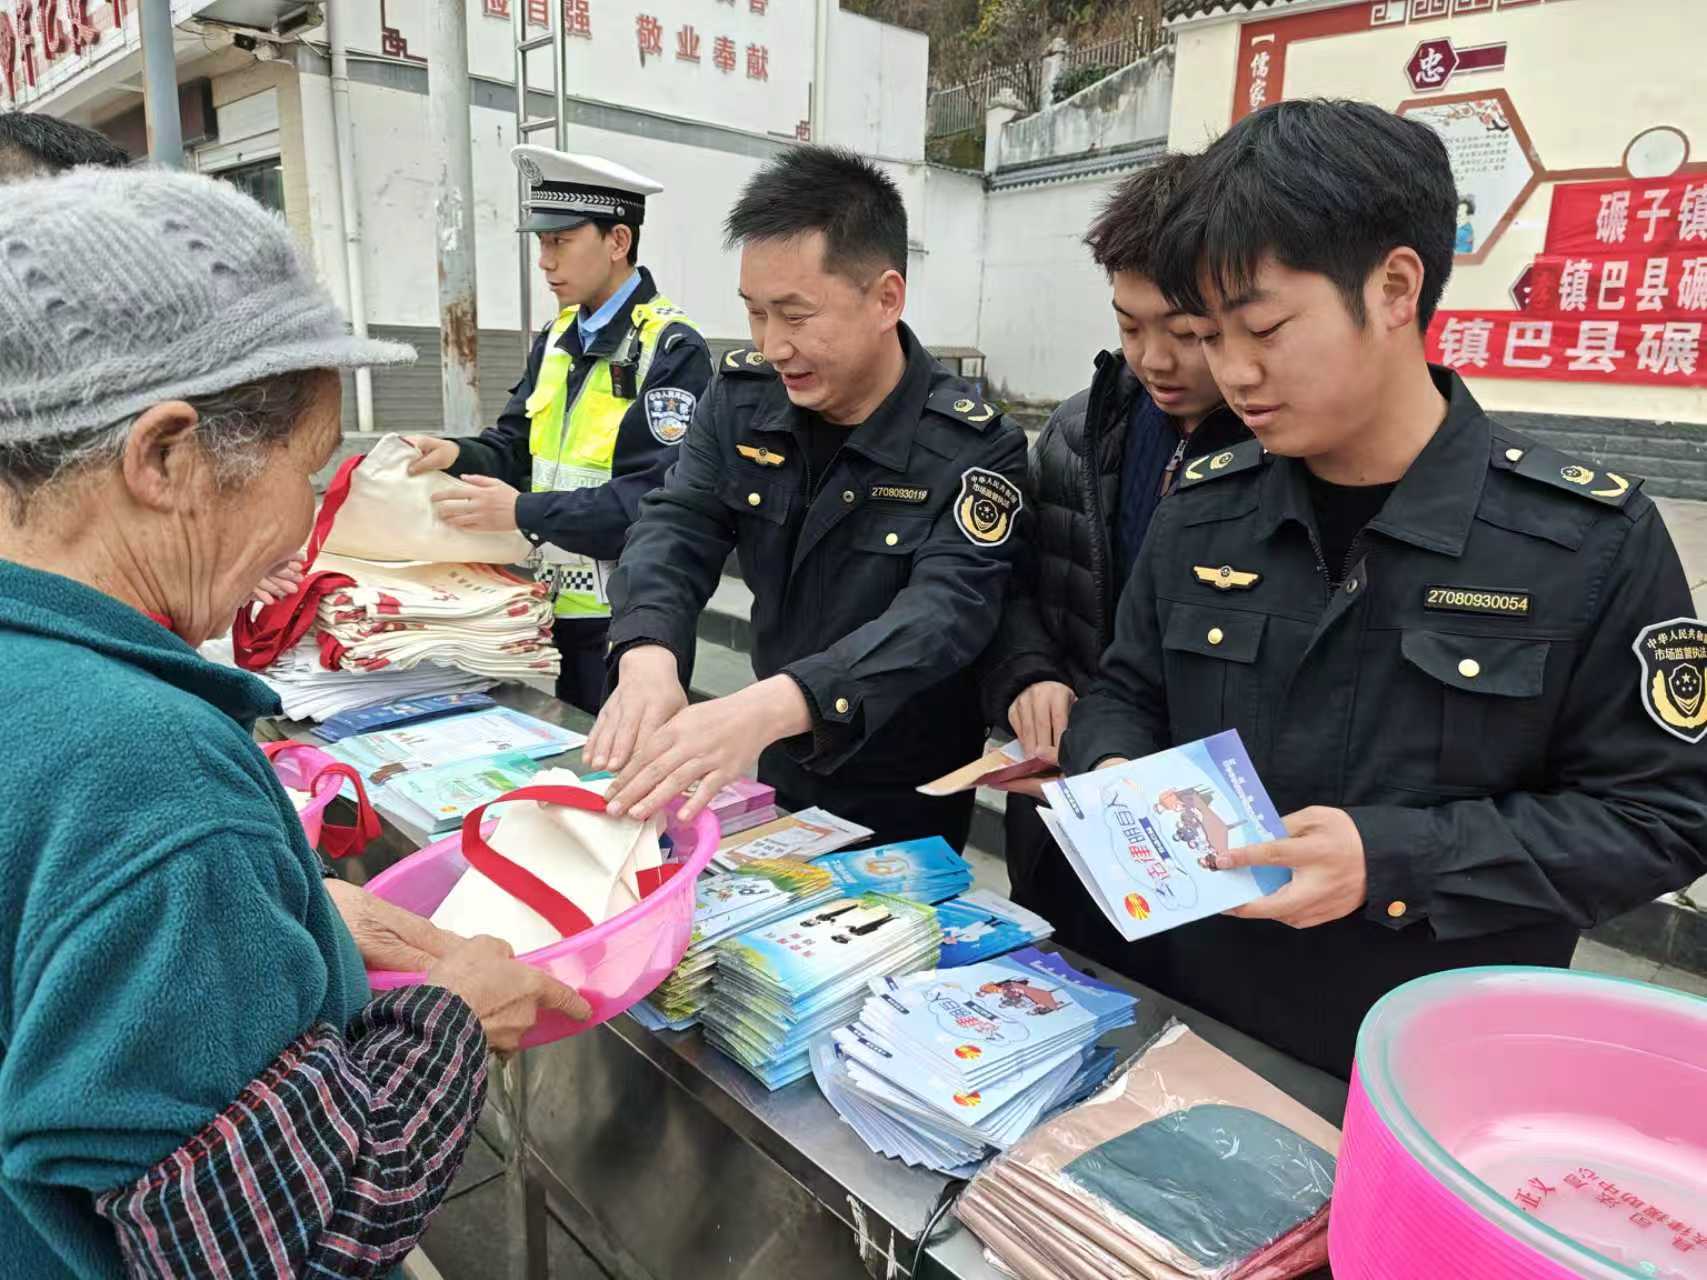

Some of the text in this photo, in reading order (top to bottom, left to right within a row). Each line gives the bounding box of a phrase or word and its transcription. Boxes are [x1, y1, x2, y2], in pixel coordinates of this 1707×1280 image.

[635, 13, 769, 81] 敬业奉献
[1415, 48, 1445, 84] 忠
[1595, 184, 1707, 243] 碾子镇
[1558, 257, 1707, 312] 镇巴县碾
[1437, 317, 1702, 376] 镇巴县碾
[1427, 589, 1529, 611] 27080930054
